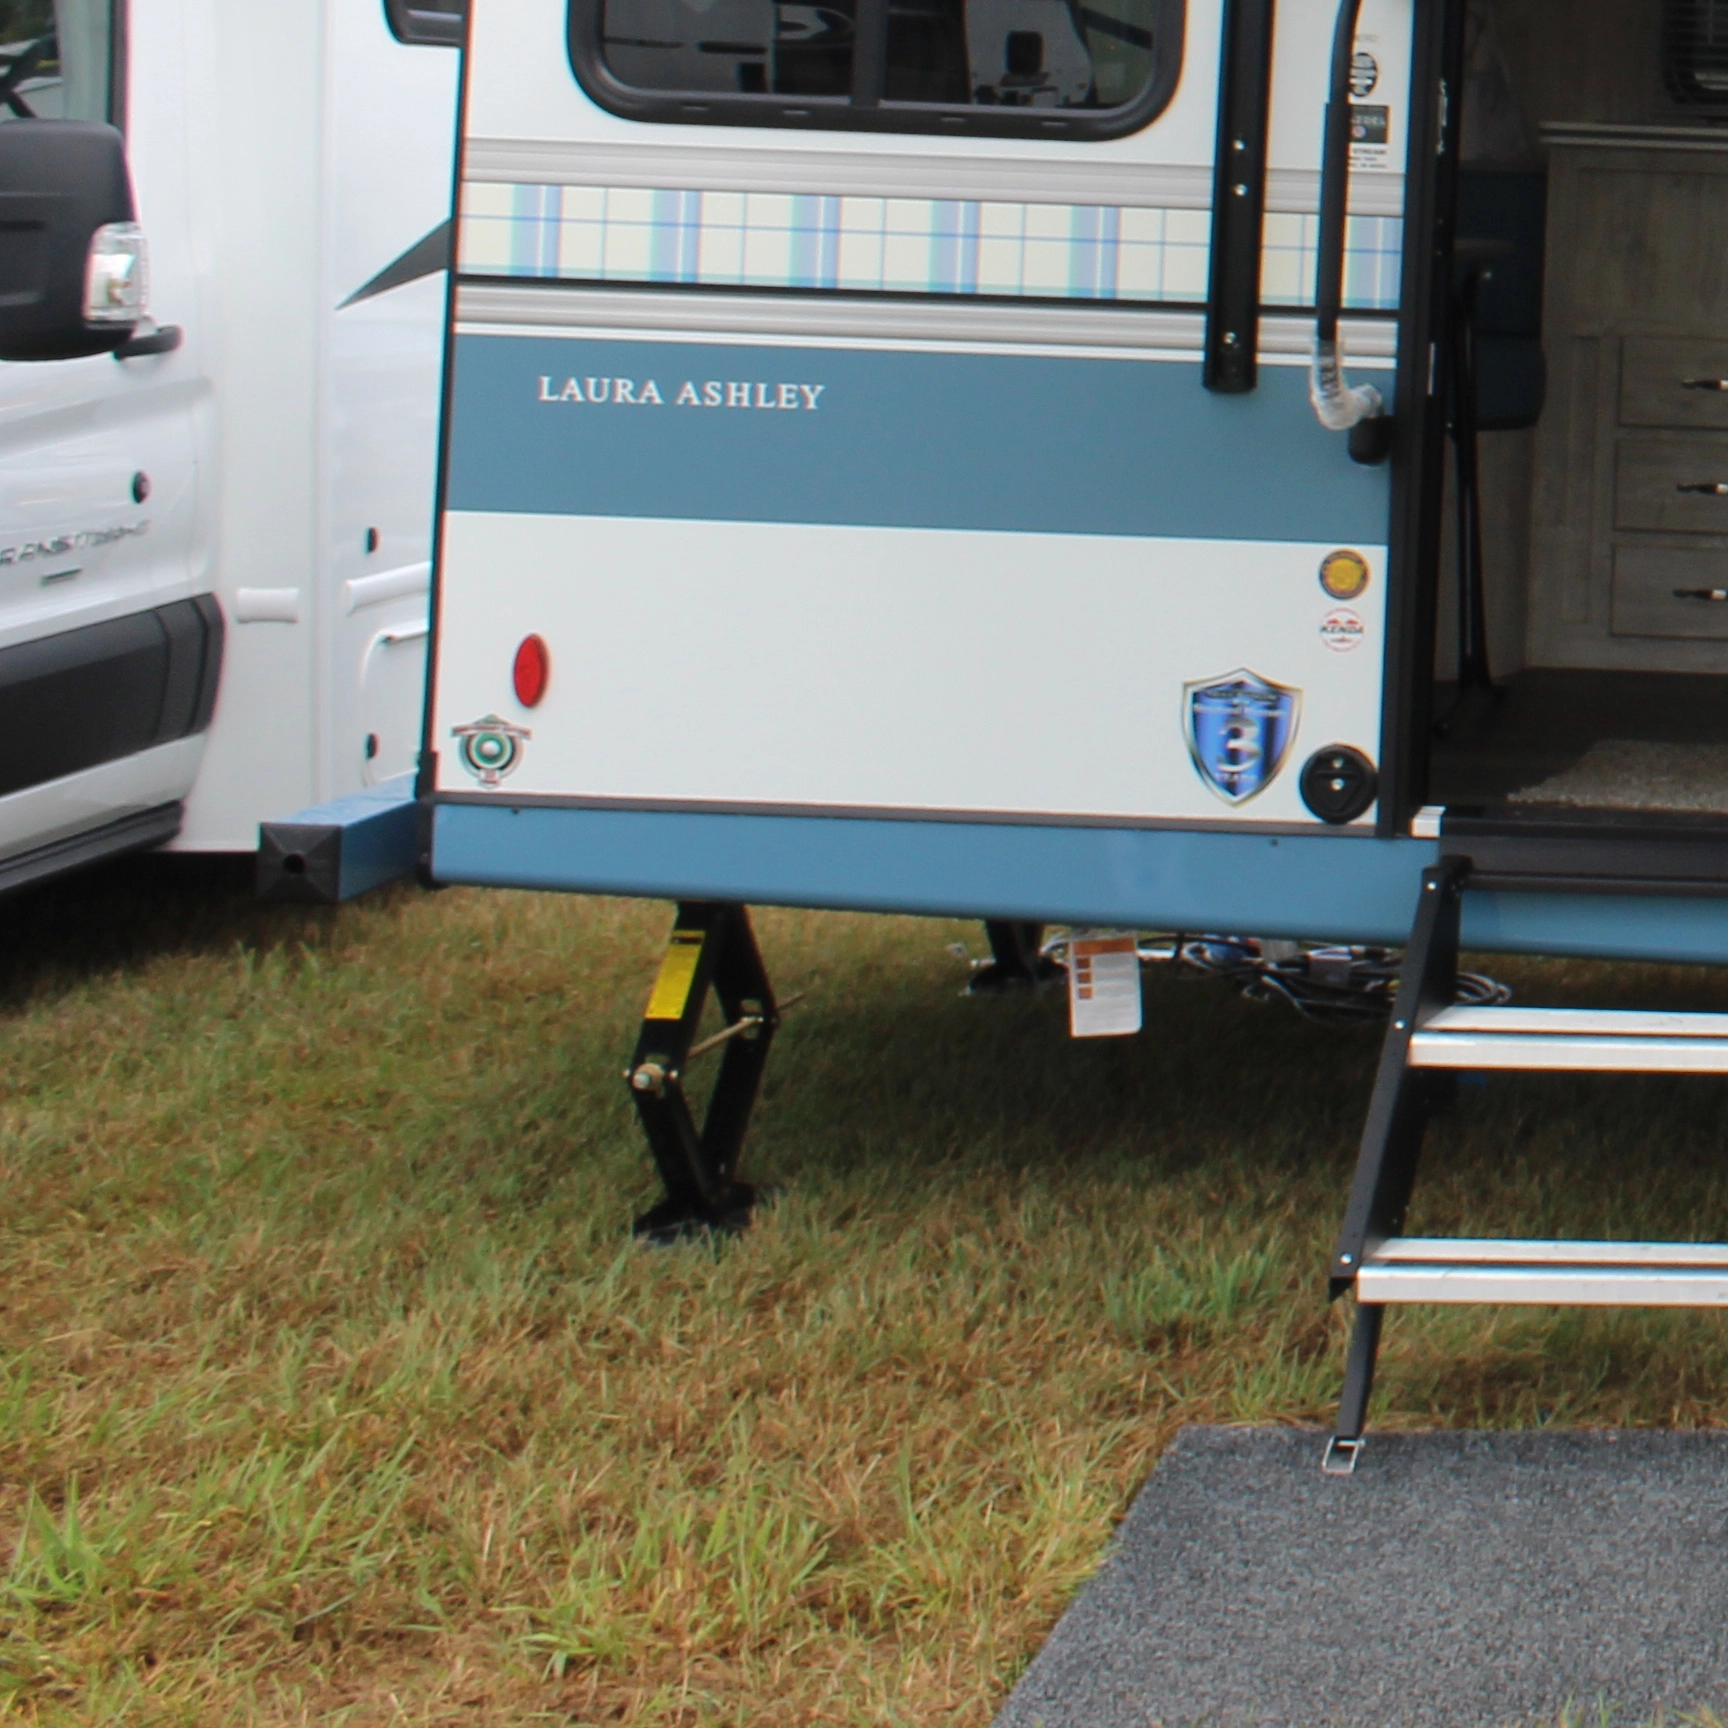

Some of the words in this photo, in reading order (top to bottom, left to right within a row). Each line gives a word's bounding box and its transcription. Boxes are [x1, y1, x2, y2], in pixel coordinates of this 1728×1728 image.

[538, 375, 665, 405] LAURA
[675, 380, 825, 410] ASHLEY
[1216, 717, 1262, 773] 3
